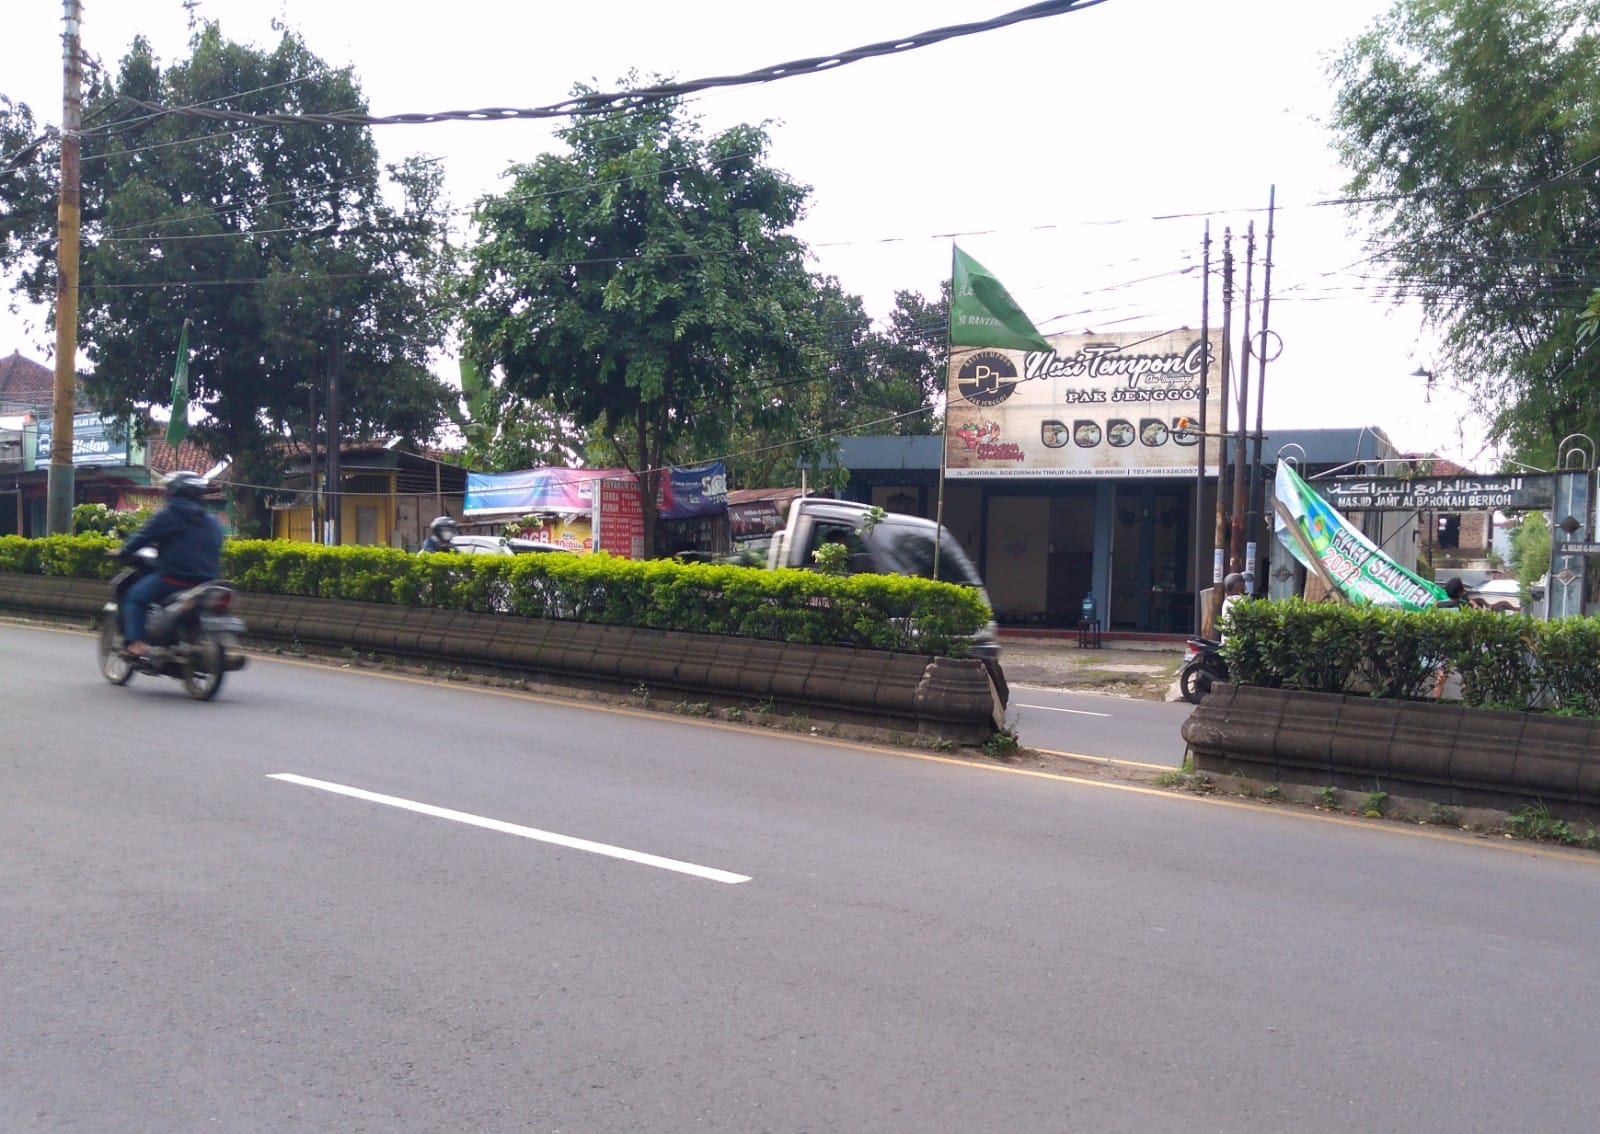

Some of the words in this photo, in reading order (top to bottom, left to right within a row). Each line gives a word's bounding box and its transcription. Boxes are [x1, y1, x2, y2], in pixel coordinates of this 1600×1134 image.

[1025, 351, 1085, 379] Nasi
[1066, 390, 1107, 403] PAK
[1338, 496, 1372, 508] MASJID
[1403, 495, 1415, 507] AL
[1417, 495, 1466, 507] BAROKAH
[1468, 494, 1512, 506] BERKOH
[1320, 546, 1361, 585] 2022
[1331, 527, 1374, 567] HARI
[1367, 555, 1434, 609] SANTRI
